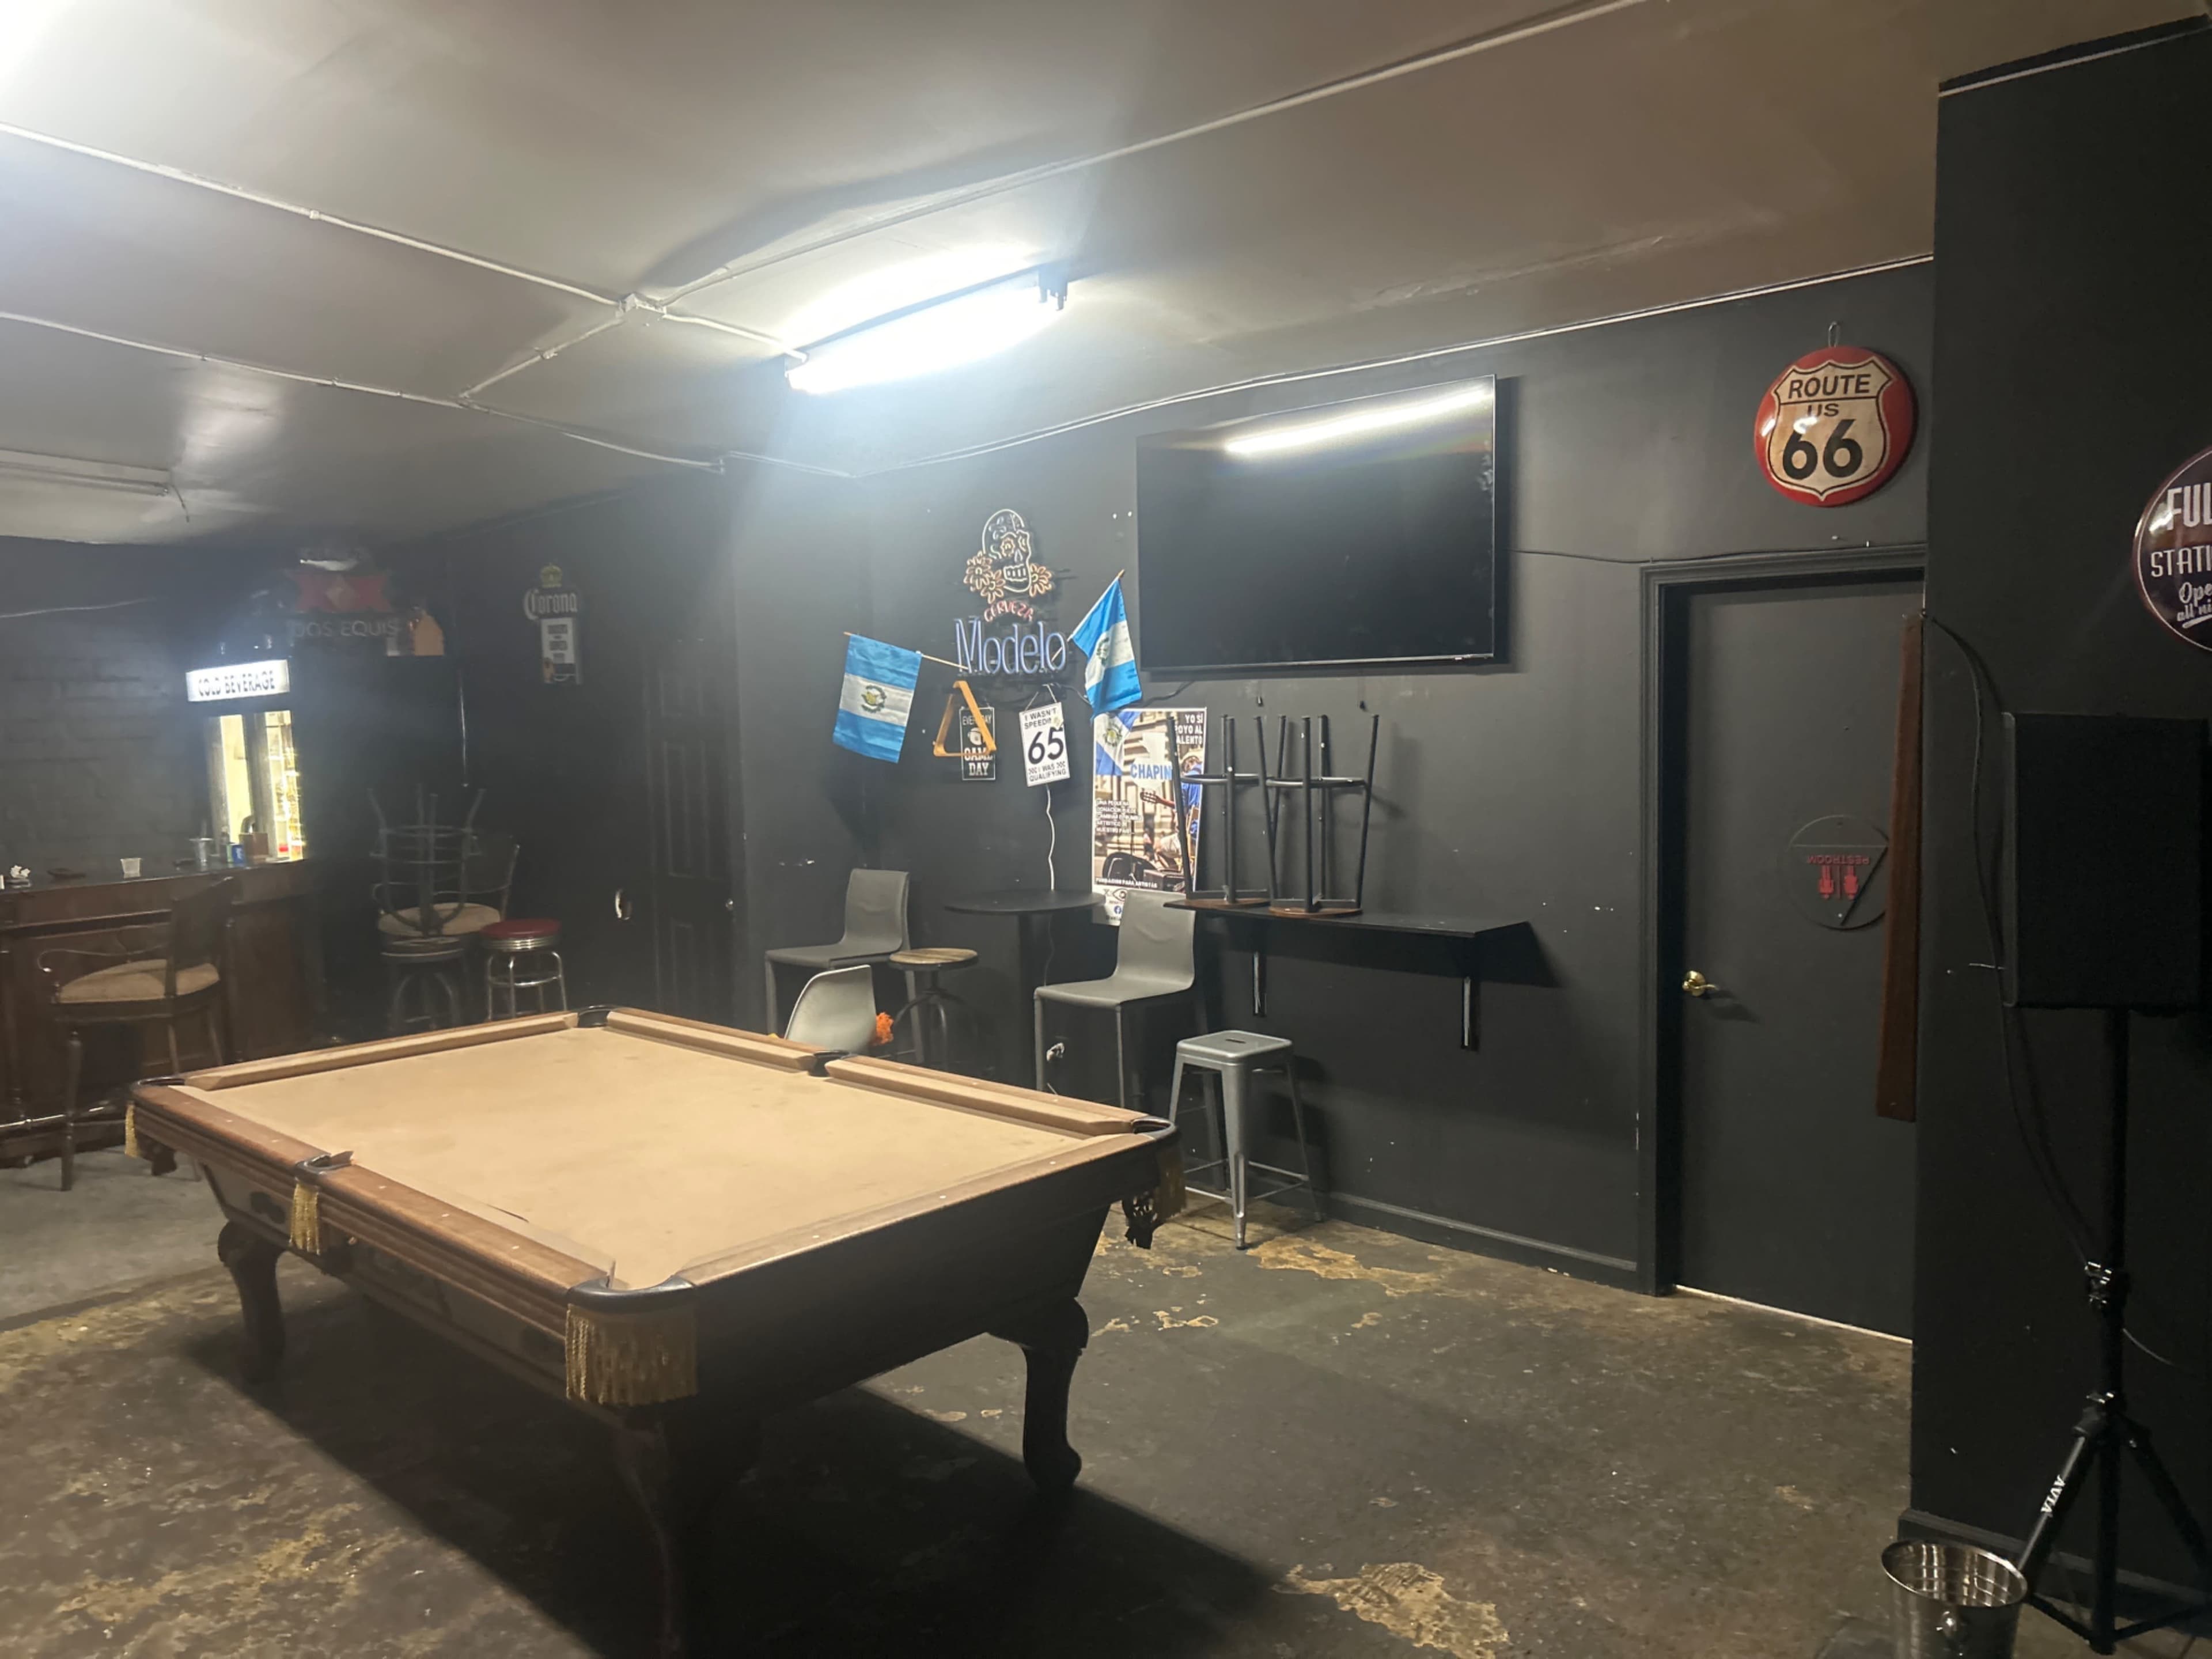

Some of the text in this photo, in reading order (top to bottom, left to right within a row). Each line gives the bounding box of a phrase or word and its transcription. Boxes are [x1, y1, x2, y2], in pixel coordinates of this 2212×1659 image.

[1788, 374, 1872, 399] ROUTE
[1807, 403, 1839, 416] US
[1782, 419, 1863, 480] 66
[524, 588, 578, 620] Corona
[984, 600, 1034, 622] CERVEZA
[955, 616, 1066, 674] Modelo
[1184, 714, 1195, 724] YO
[1175, 725, 1203, 734] POYO AL
[1028, 726, 1064, 765] 65
[1176, 735, 1202, 745] ALENTO
[968, 762, 989, 776] DAY
[1130, 763, 1173, 780] CHAPIN
